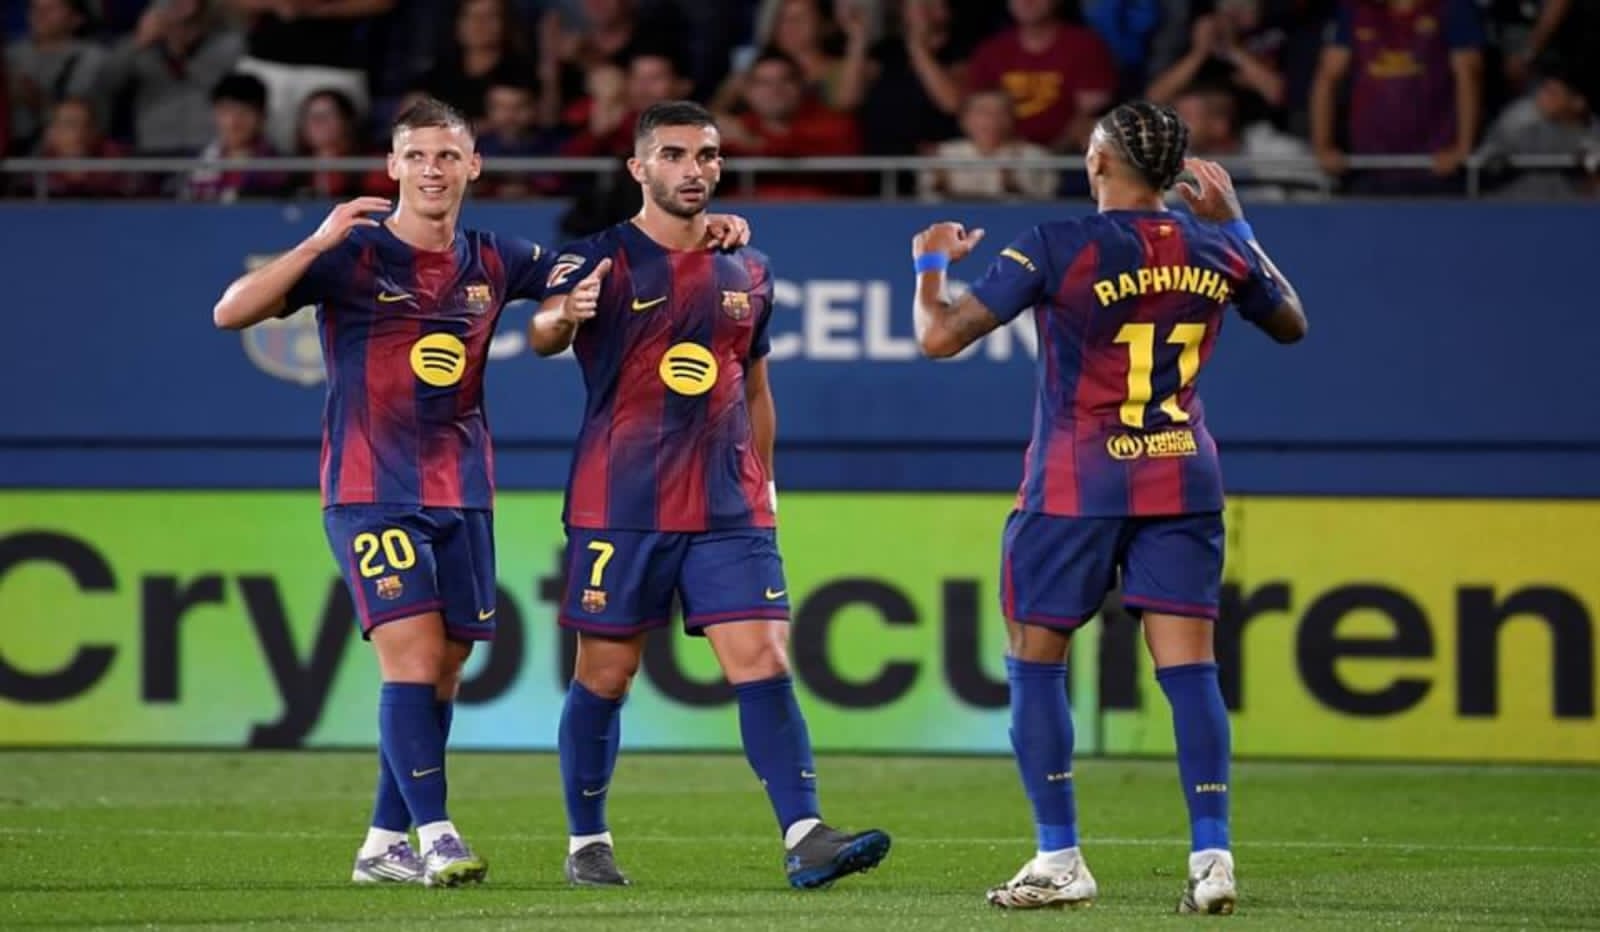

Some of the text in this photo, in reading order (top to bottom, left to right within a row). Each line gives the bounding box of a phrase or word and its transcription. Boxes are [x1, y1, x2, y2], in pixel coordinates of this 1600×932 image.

[1112, 323, 1206, 428] 11
[354, 528, 416, 578] 20
[587, 541, 615, 586] 7
[0, 528, 1596, 747] Crycuren
